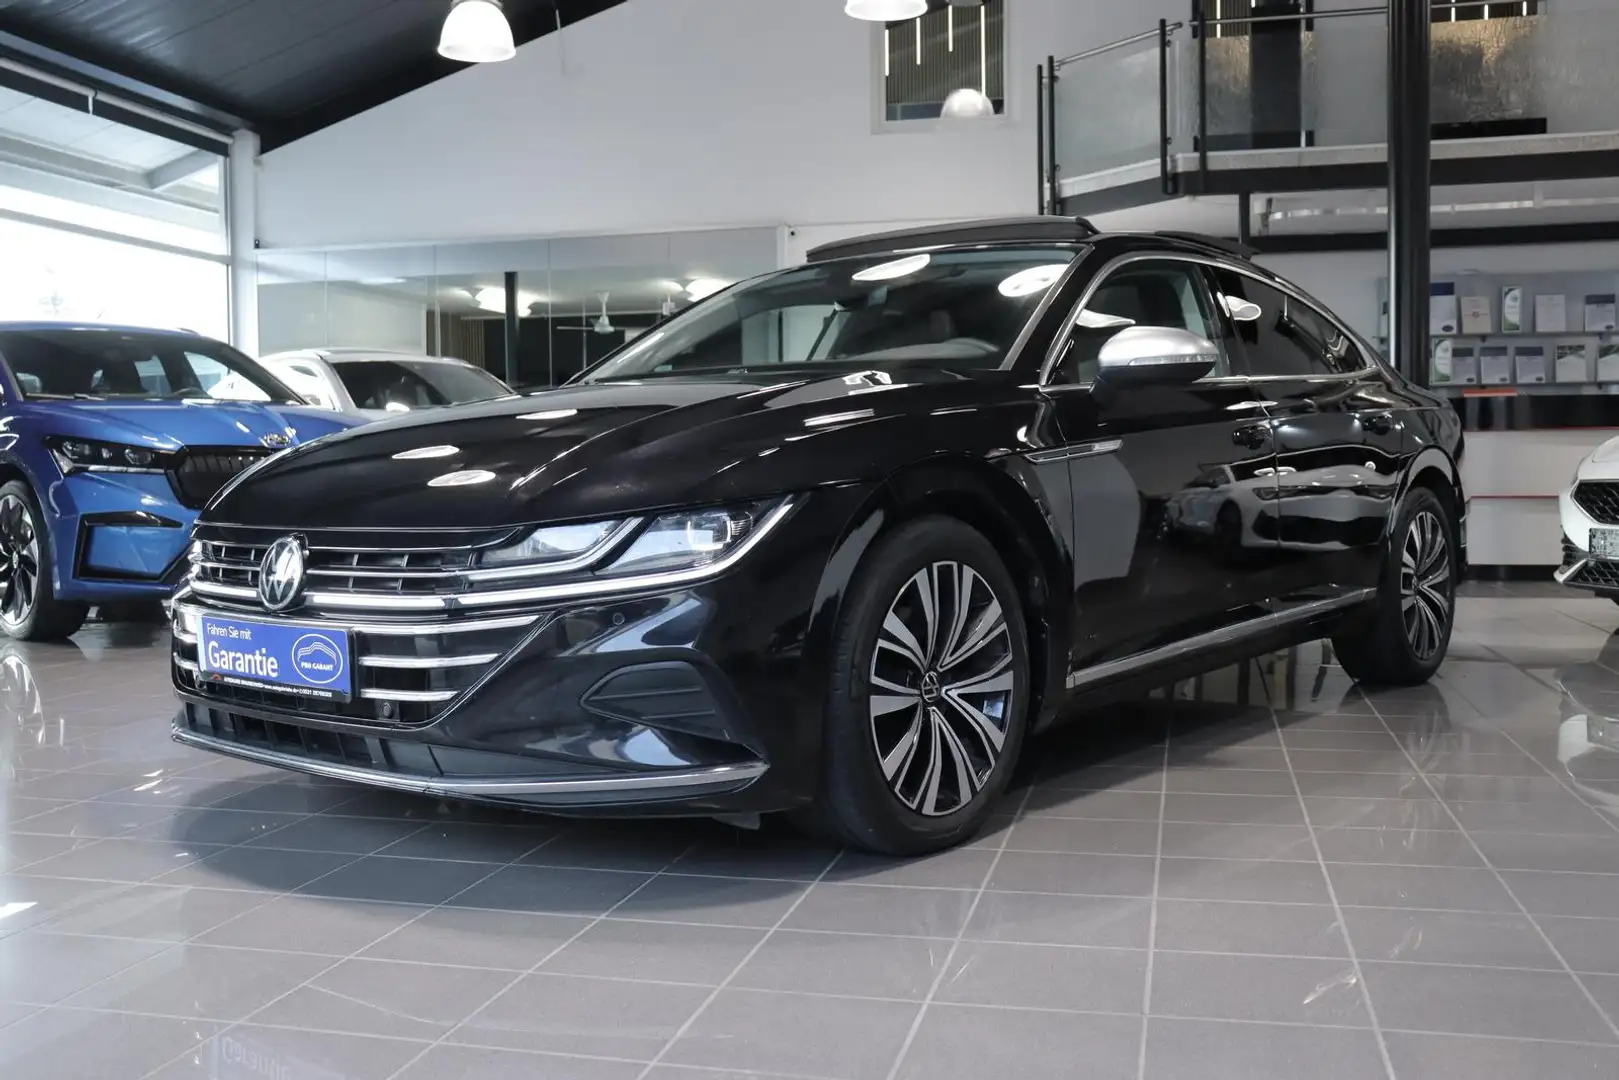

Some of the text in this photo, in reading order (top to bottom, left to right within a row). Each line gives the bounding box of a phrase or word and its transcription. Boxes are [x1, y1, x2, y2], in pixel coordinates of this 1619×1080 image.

[207, 622, 252, 641] Fahren Sie mit
[208, 640, 279, 678] Garantie
[301, 661, 334, 672] PRO GARANT
